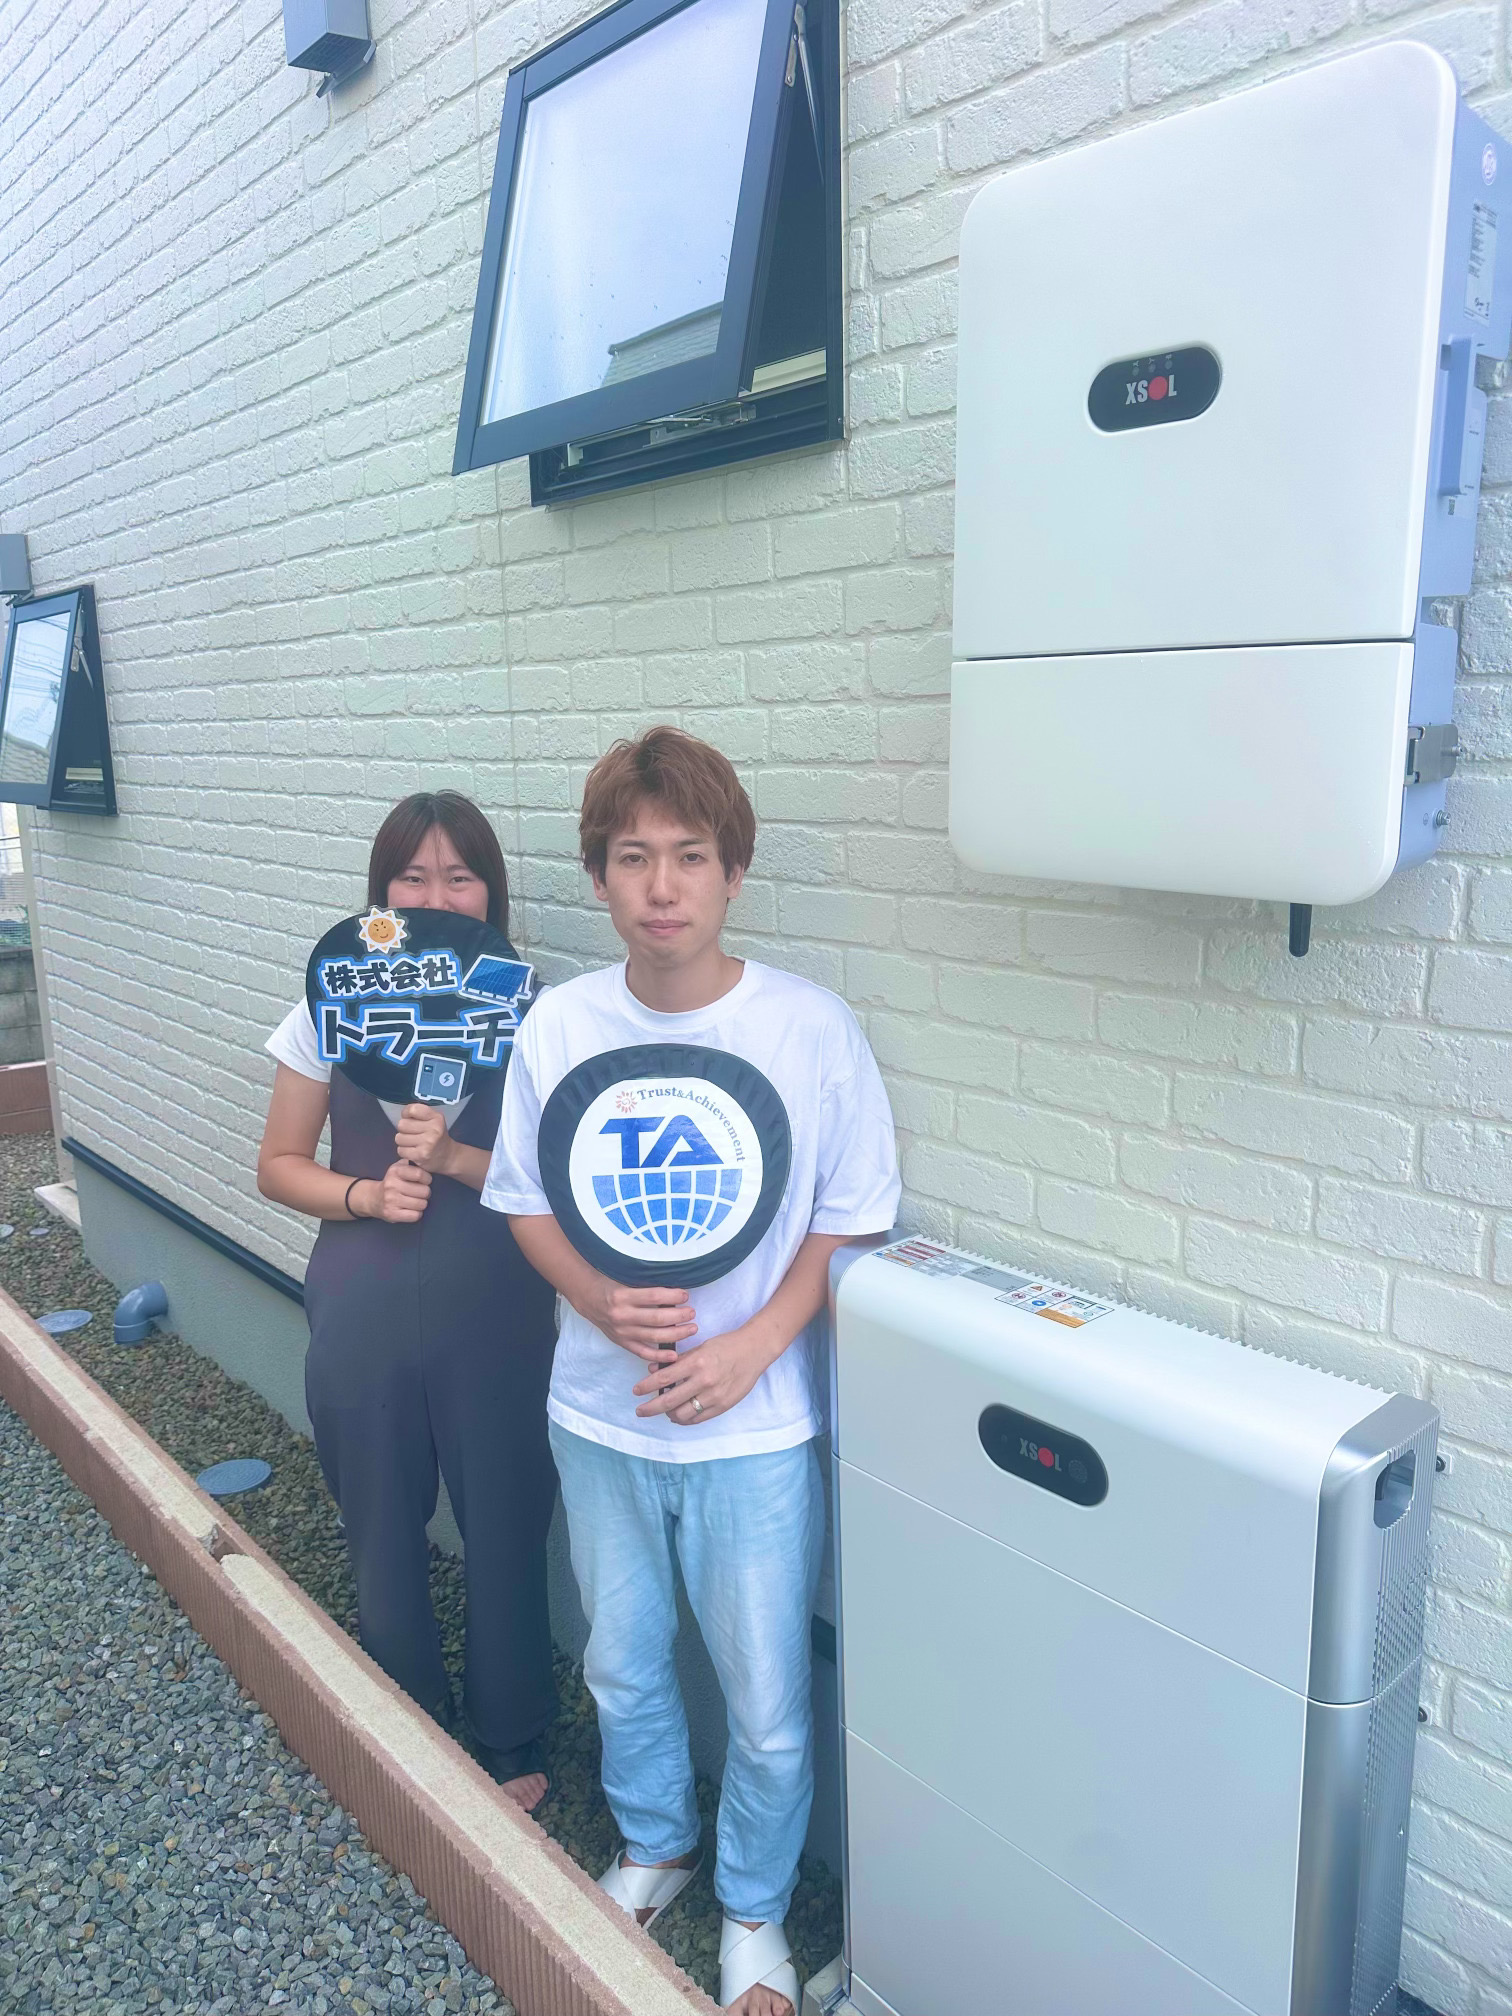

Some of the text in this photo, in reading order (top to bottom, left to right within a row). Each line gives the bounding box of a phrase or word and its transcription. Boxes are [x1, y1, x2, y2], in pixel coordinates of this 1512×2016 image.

[1125, 374, 1178, 405] XSOL
[323, 955, 457, 996] 株式会社
[323, 1007, 516, 1059] トラーチ
[599, 1114, 724, 1169] TA
[1019, 1437, 1063, 1472] XSOL
